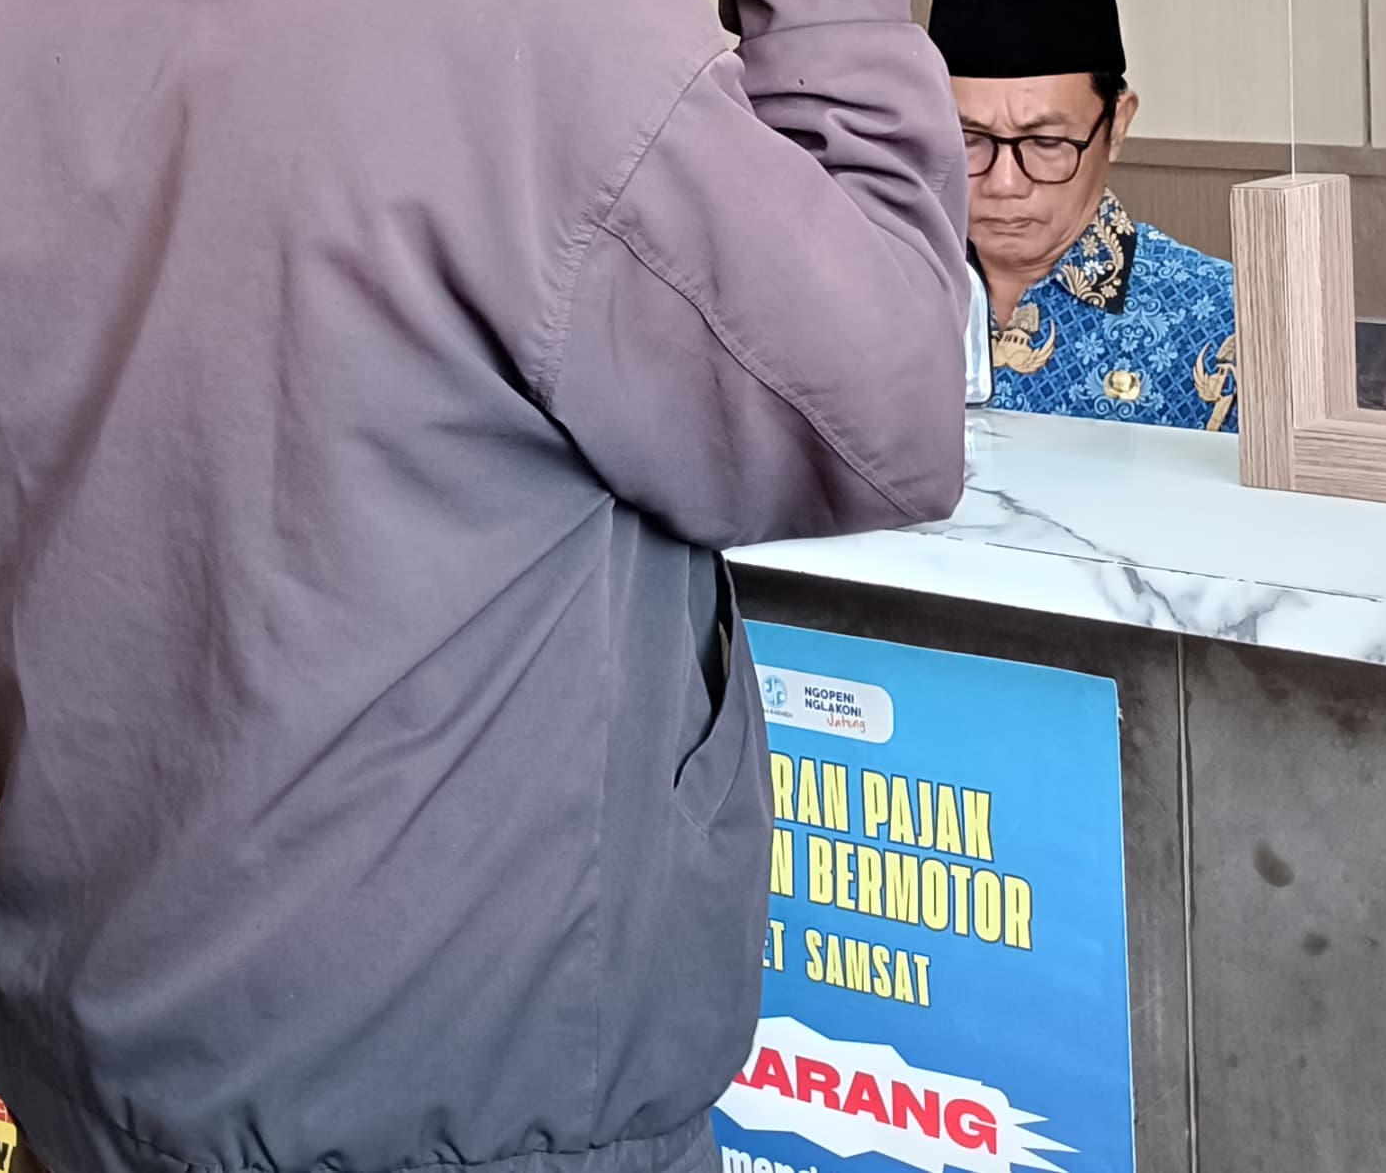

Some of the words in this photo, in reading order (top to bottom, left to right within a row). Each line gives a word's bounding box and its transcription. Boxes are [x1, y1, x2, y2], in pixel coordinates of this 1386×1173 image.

[804, 685, 855, 704] NGOPENI
[804, 698, 863, 718] NGLAKONI
[826, 713, 866, 734] Jateng
[860, 769, 994, 863] PAJAK
[807, 833, 1034, 952] BERMOTOR
[803, 928, 932, 1008] SAMSAT
[732, 1045, 998, 1155] ARANG
